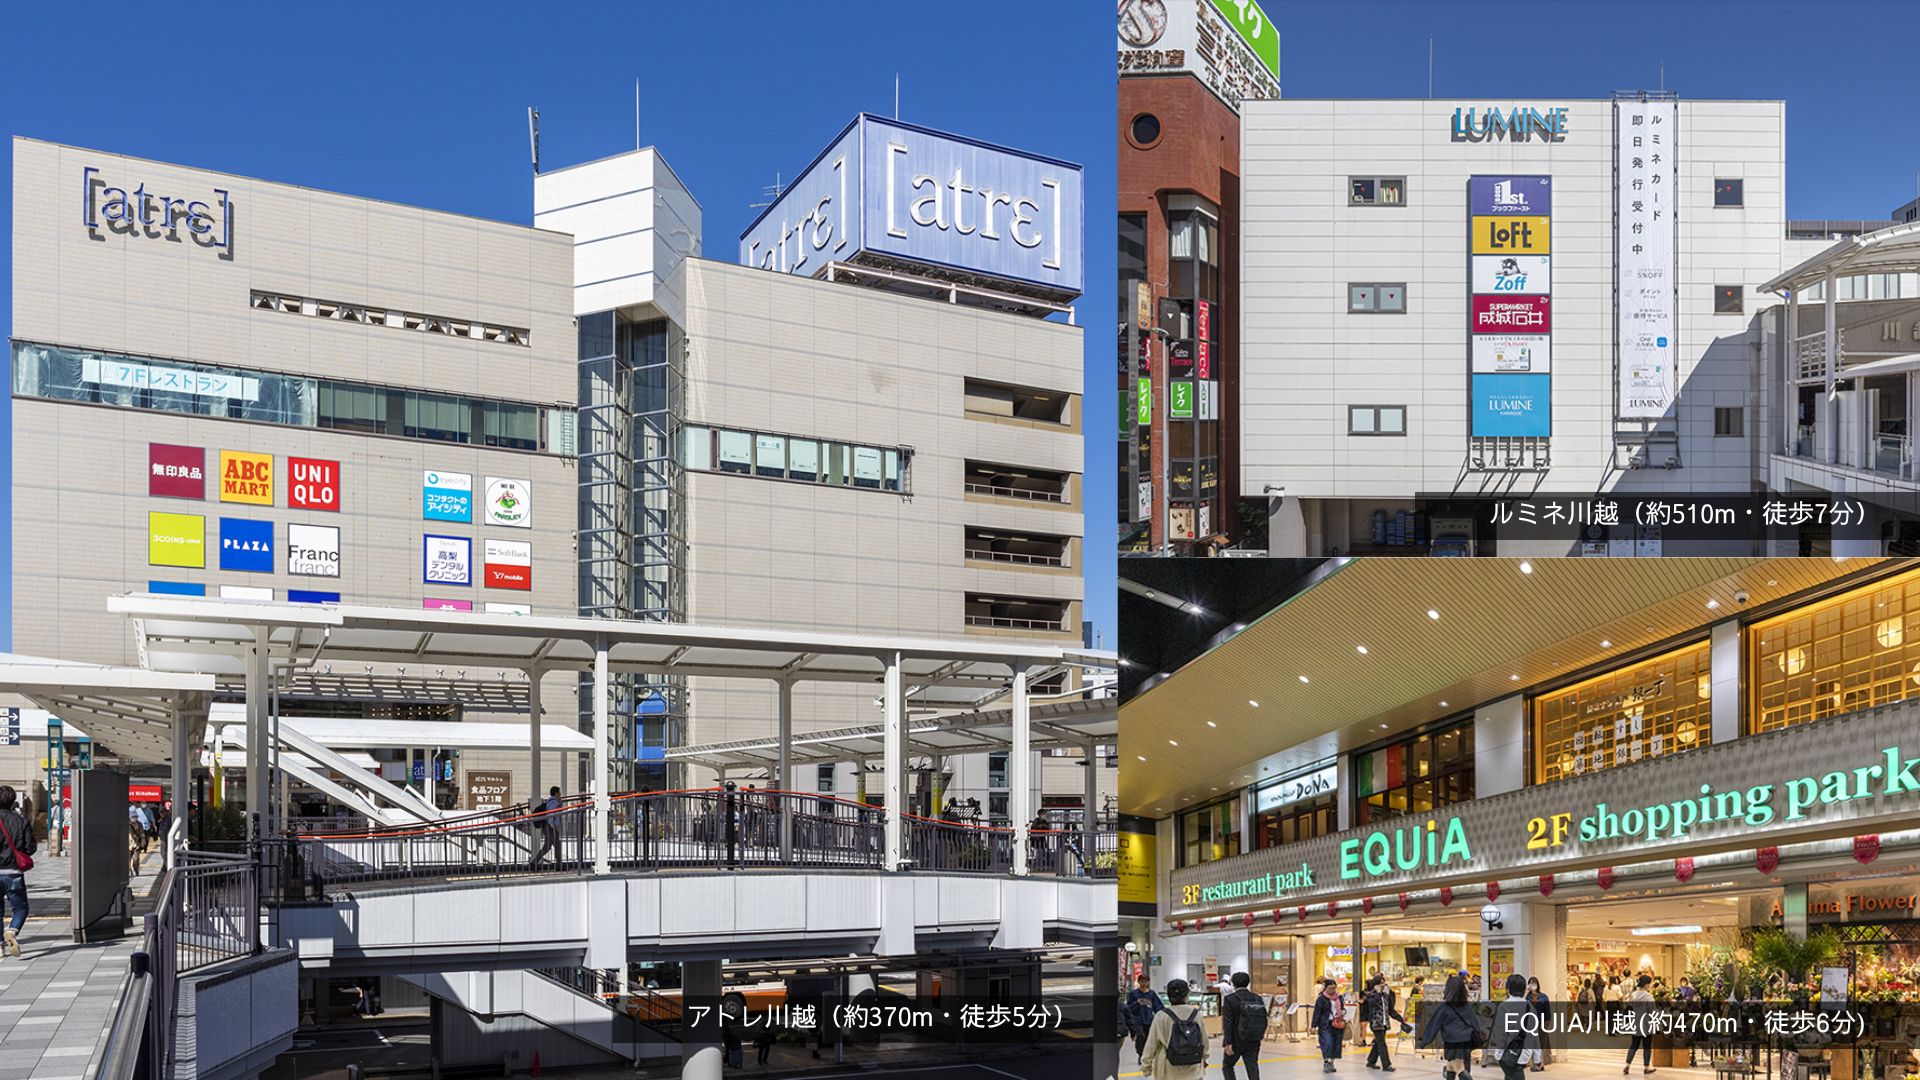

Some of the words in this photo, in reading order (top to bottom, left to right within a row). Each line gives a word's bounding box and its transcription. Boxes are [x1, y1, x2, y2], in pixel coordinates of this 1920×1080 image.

[1455, 107, 1569, 134] LUMINE
[1650, 114, 1663, 222] ルミネカード
[1631, 114, 1644, 256] 即日発行受付中
[1494, 275, 1527, 291] Zoff
[1489, 303, 1534, 311] SUPERMARKET
[1479, 311, 1543, 325] 成城石井
[1139, 382, 1148, 418] レイク
[1177, 383, 1186, 408] レイク
[1630, 399, 1664, 408] LUMINE
[1489, 399, 1534, 411] LUMINE
[152, 463, 202, 480] 無印良品
[224, 458, 269, 482] ABC
[294, 463, 331, 484] UNI
[224, 480, 269, 497] MART
[294, 484, 334, 504] QLO
[427, 494, 468, 504] コンタクトの
[427, 502, 467, 515] アイシティ
[494, 512, 522, 521] PARSLEY
[224, 538, 270, 552] PLAZA
[288, 545, 339, 562] Franc
[498, 549, 528, 558] SoftBank
[438, 550, 458, 561] 高梨
[295, 559, 335, 577] franc
[432, 560, 464, 571] デンタル
[429, 570, 467, 580] クリニック
[471, 785, 508, 794] 食品フロア
[1526, 812, 1572, 850] 2F
[1579, 783, 1776, 843] shopping
[1785, 744, 1920, 820] park
[1182, 884, 1201, 905] 3F
[1202, 876, 1273, 902] restaurant
[1275, 863, 1315, 897] park
[1847, 895, 1917, 912] Flower
